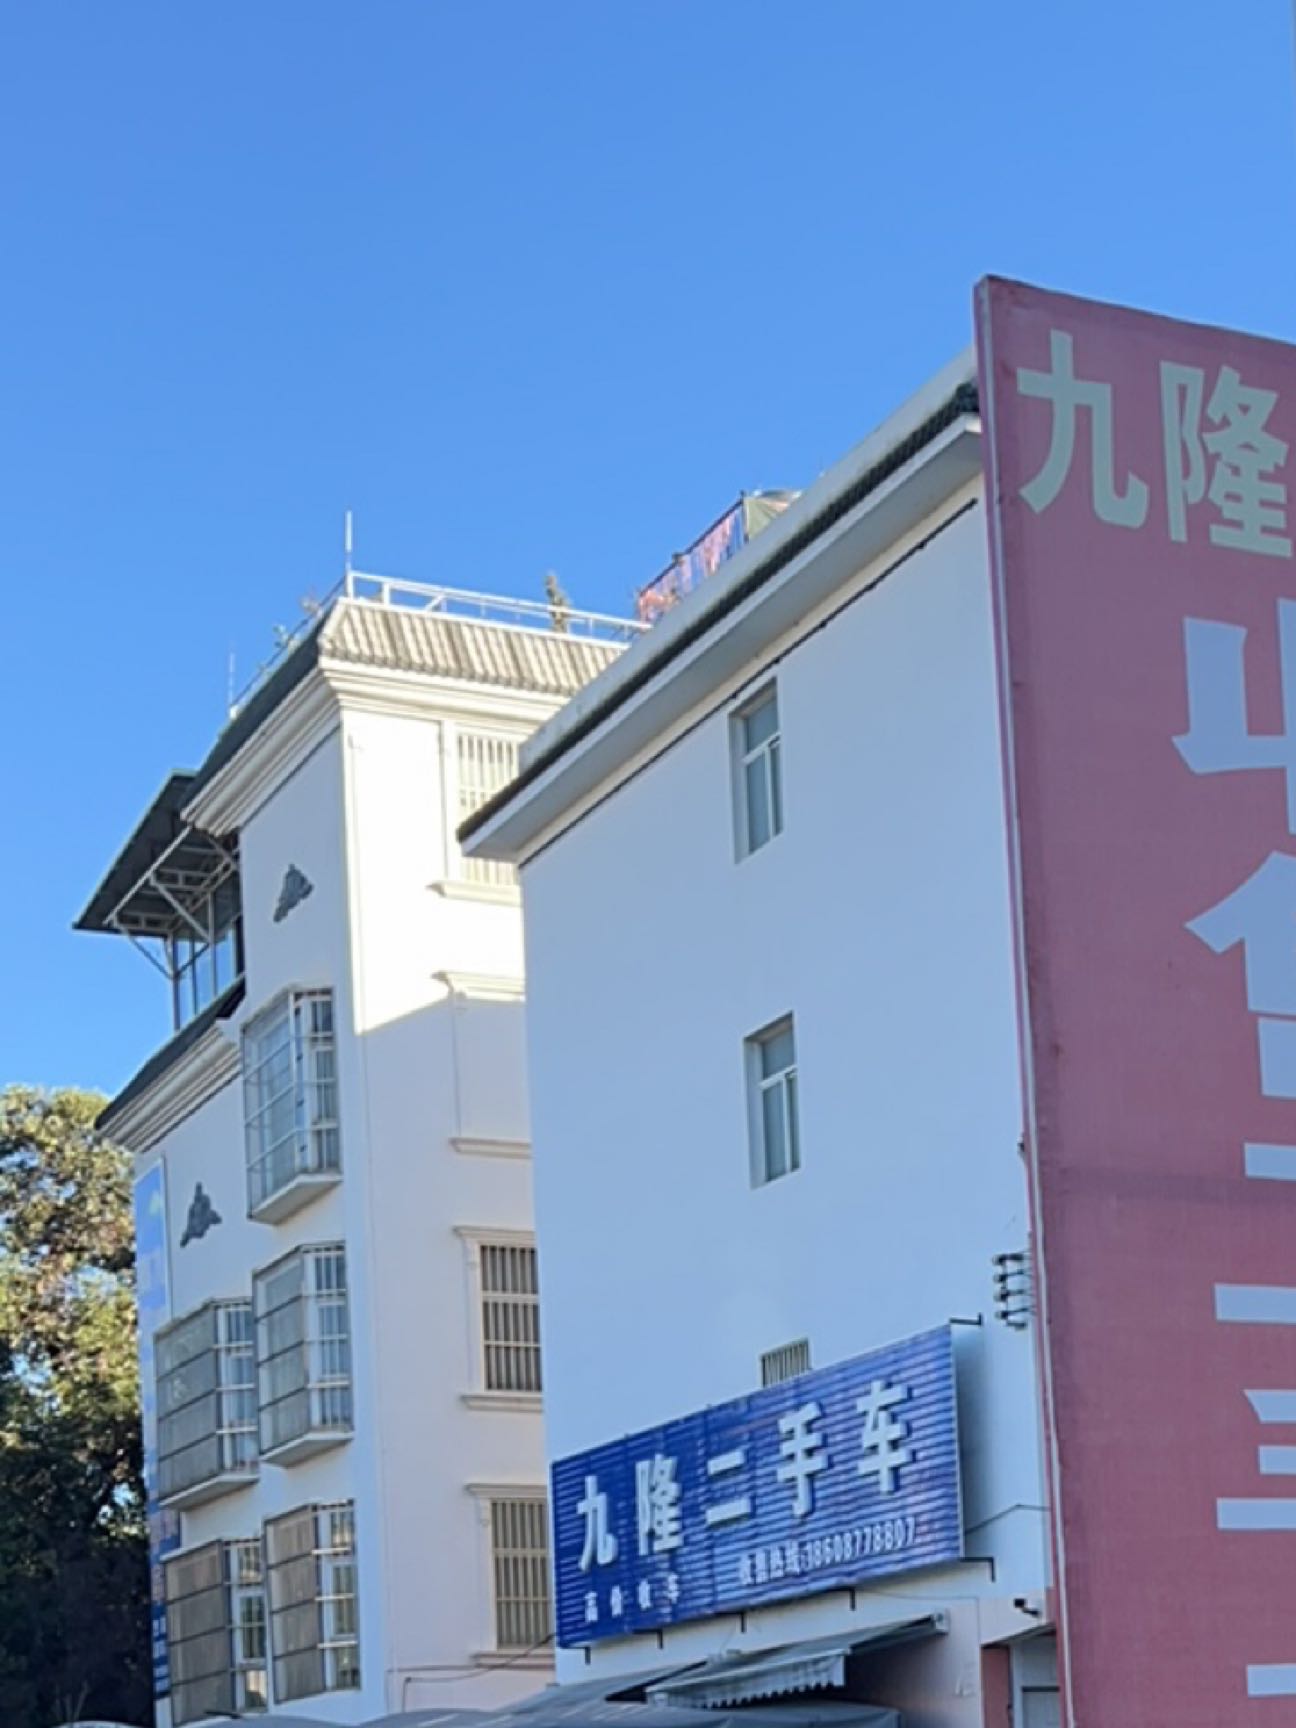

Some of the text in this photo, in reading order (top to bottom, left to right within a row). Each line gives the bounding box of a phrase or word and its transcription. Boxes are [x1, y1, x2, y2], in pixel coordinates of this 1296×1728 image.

[577, 1379, 914, 1573] 九隆二手车
